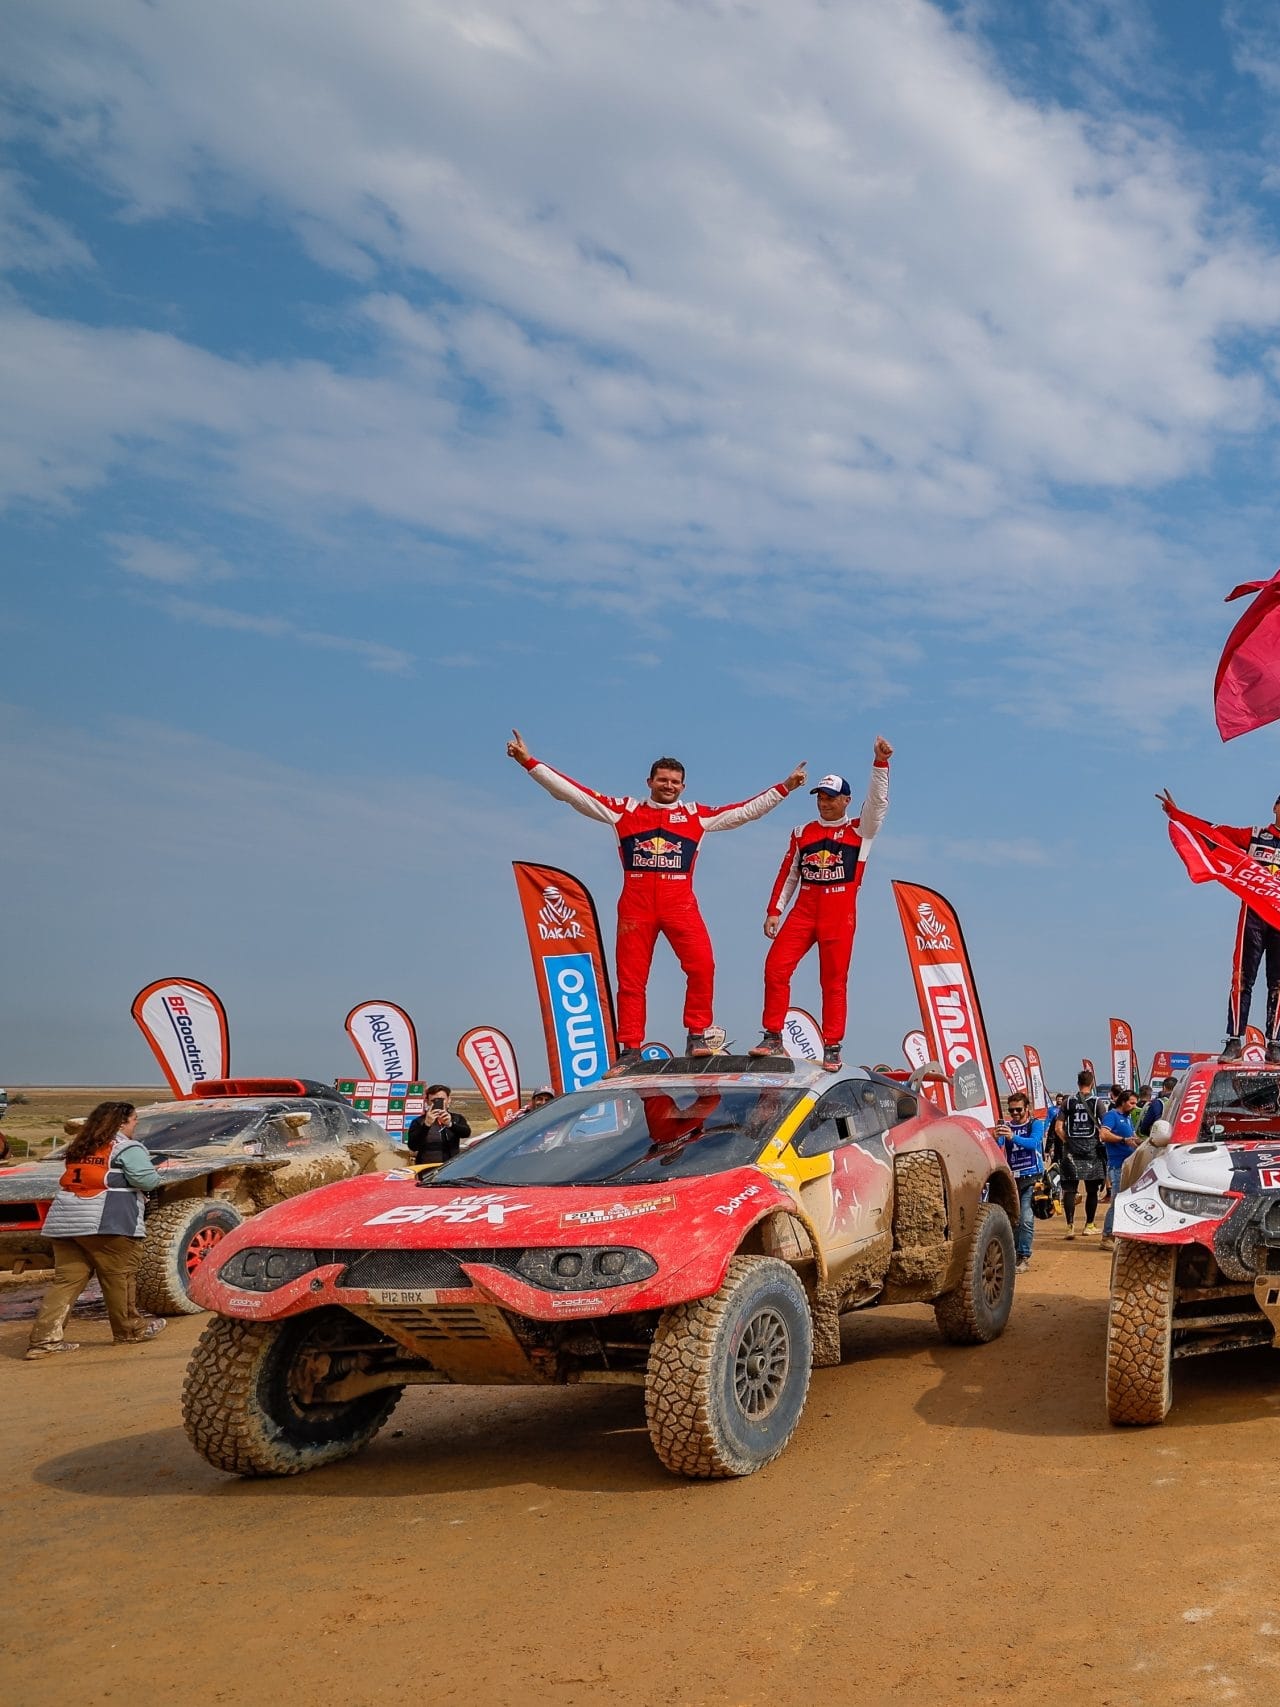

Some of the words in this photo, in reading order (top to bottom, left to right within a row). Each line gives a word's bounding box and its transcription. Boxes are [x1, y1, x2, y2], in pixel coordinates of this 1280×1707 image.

[633, 854, 657, 867] Red
[658, 855, 681, 869] Bull
[802, 867, 822, 880] Red
[823, 866, 845, 880] Bull
[537, 921, 586, 941] DAKAR
[915, 935, 955, 951] DAKAR
[167, 996, 207, 1081] BFGoodrich
[558, 968, 597, 1091] ramco
[784, 1019, 817, 1061] AQUAFI
[936, 990, 974, 1077] OTUL
[364, 1014, 404, 1081] AQUAFINA
[476, 1041, 511, 1098] MOTUL
[1010, 1061, 1024, 1086] MOTUL
[1117, 1060, 1126, 1090] AFINA
[1073, 1112, 1088, 1122] 10
[72, 1168, 83, 1184] 1
[363, 1203, 532, 1226] BRX
[1129, 1202, 1159, 1224] eurol
